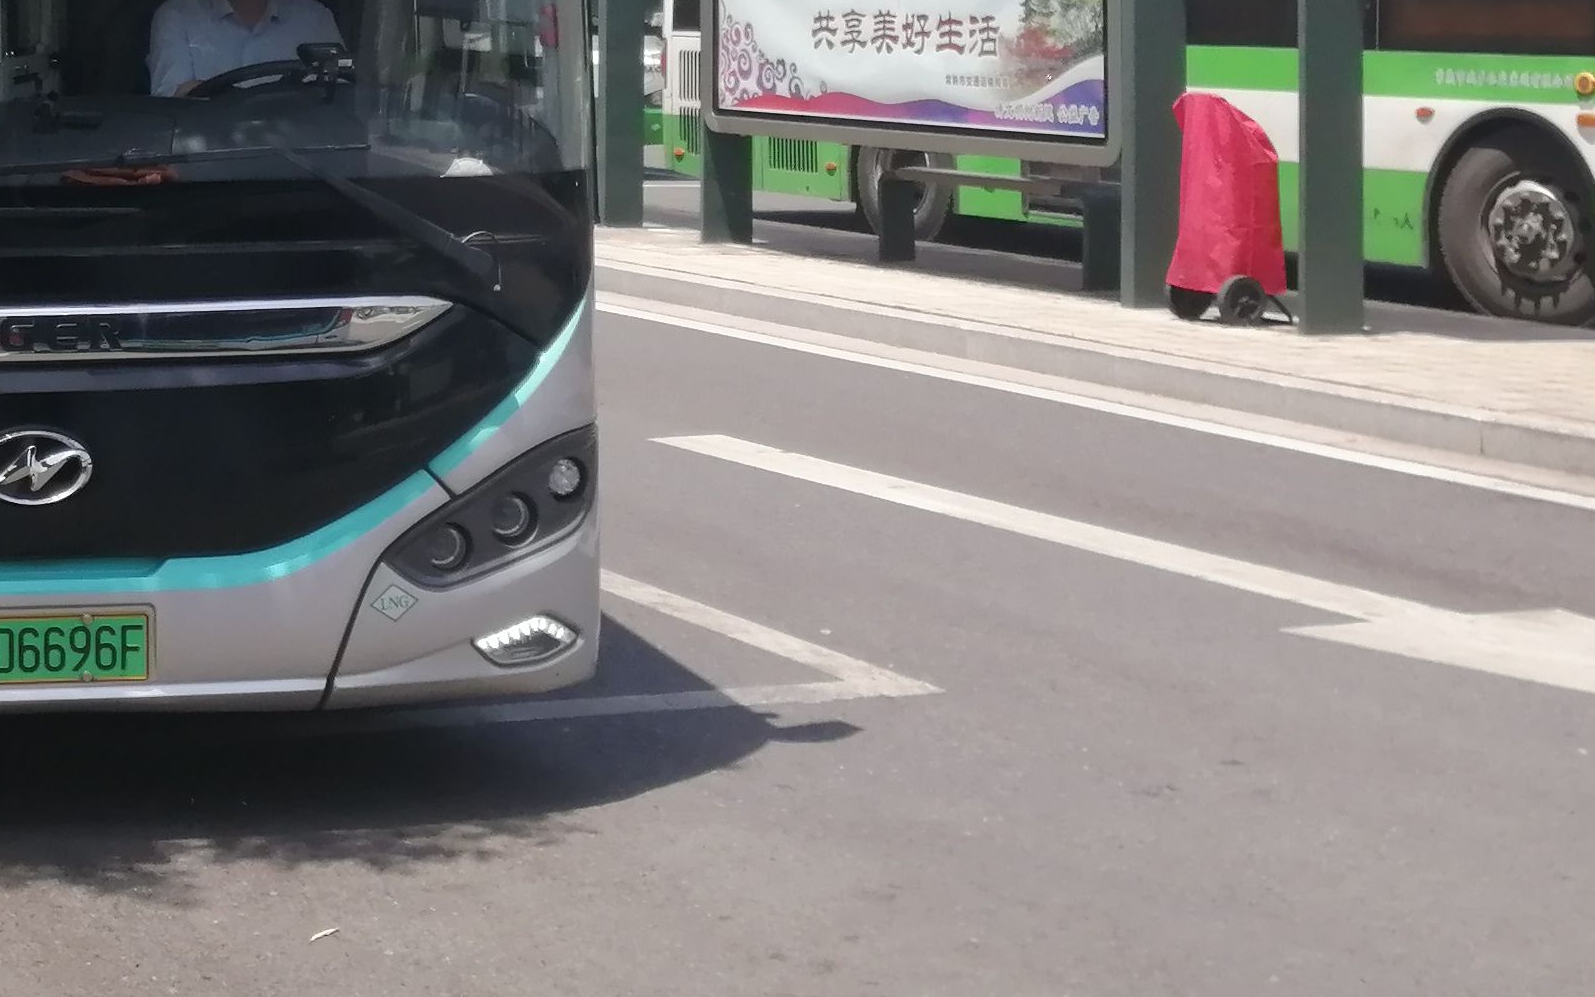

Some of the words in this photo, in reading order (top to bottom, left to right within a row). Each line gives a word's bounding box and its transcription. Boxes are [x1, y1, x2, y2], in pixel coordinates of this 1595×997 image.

[811, 8, 1001, 58] 共享美好生活
[380, 594, 409, 611] LNG
